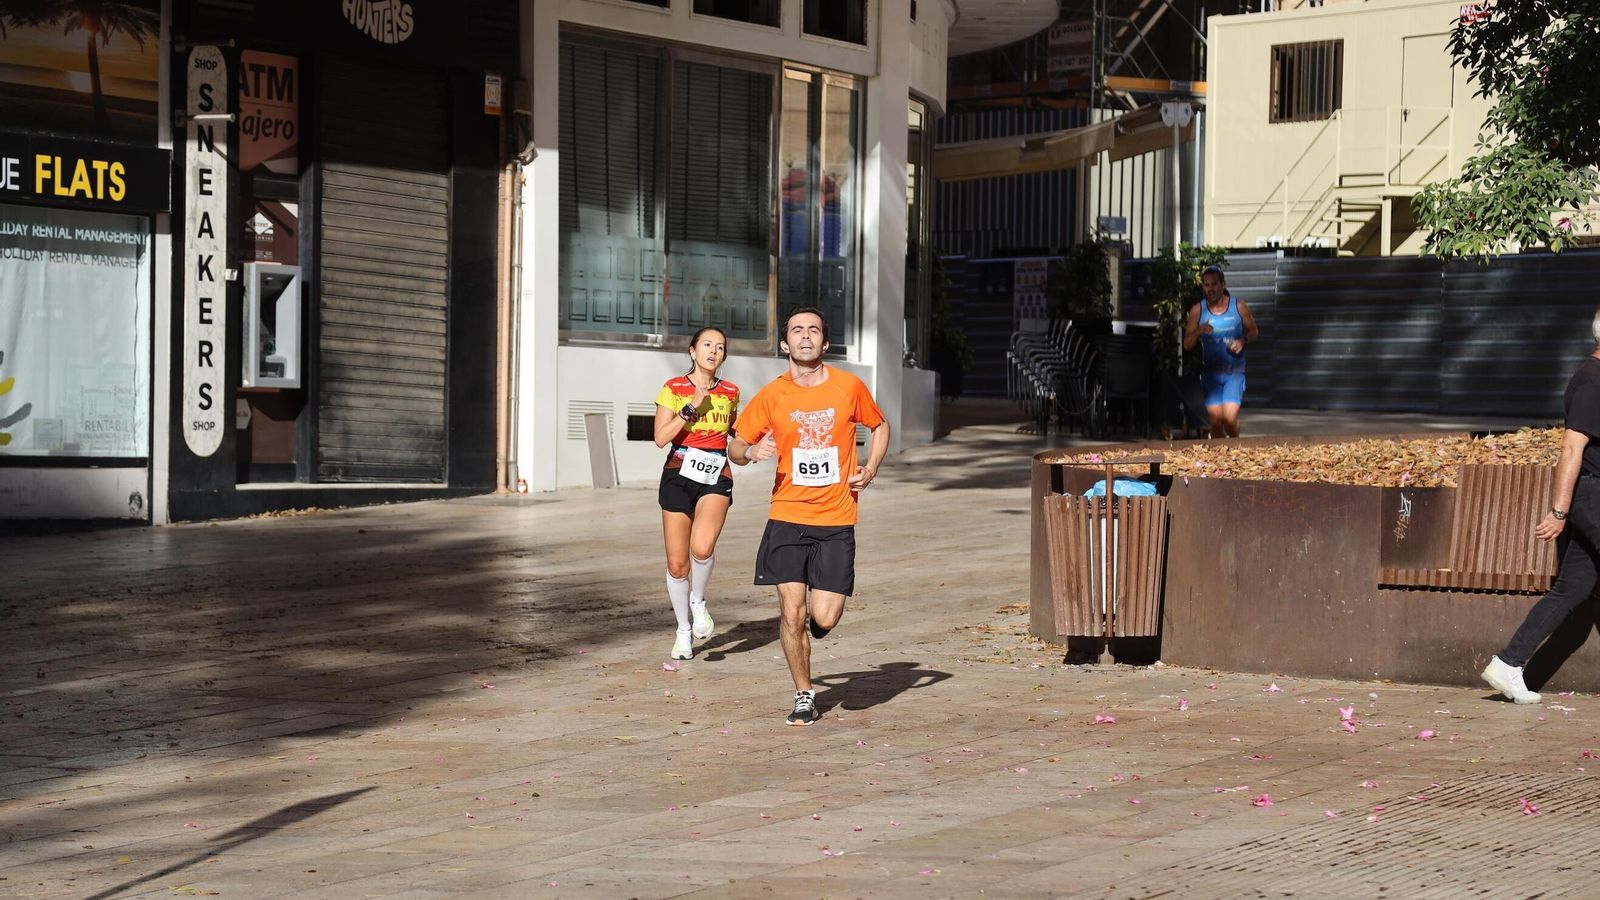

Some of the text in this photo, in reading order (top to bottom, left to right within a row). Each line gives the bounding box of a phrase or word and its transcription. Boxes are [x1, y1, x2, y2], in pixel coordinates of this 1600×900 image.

[342, 0, 414, 44] HUNTERS
[194, 58, 218, 71] SHOP
[241, 108, 295, 142] ajero
[35, 154, 126, 201] FLATS
[197, 83, 214, 411] SNEAKERS
[192, 421, 216, 431] SHOP
[690, 459, 720, 475] 1027
[798, 461, 830, 475] 691
